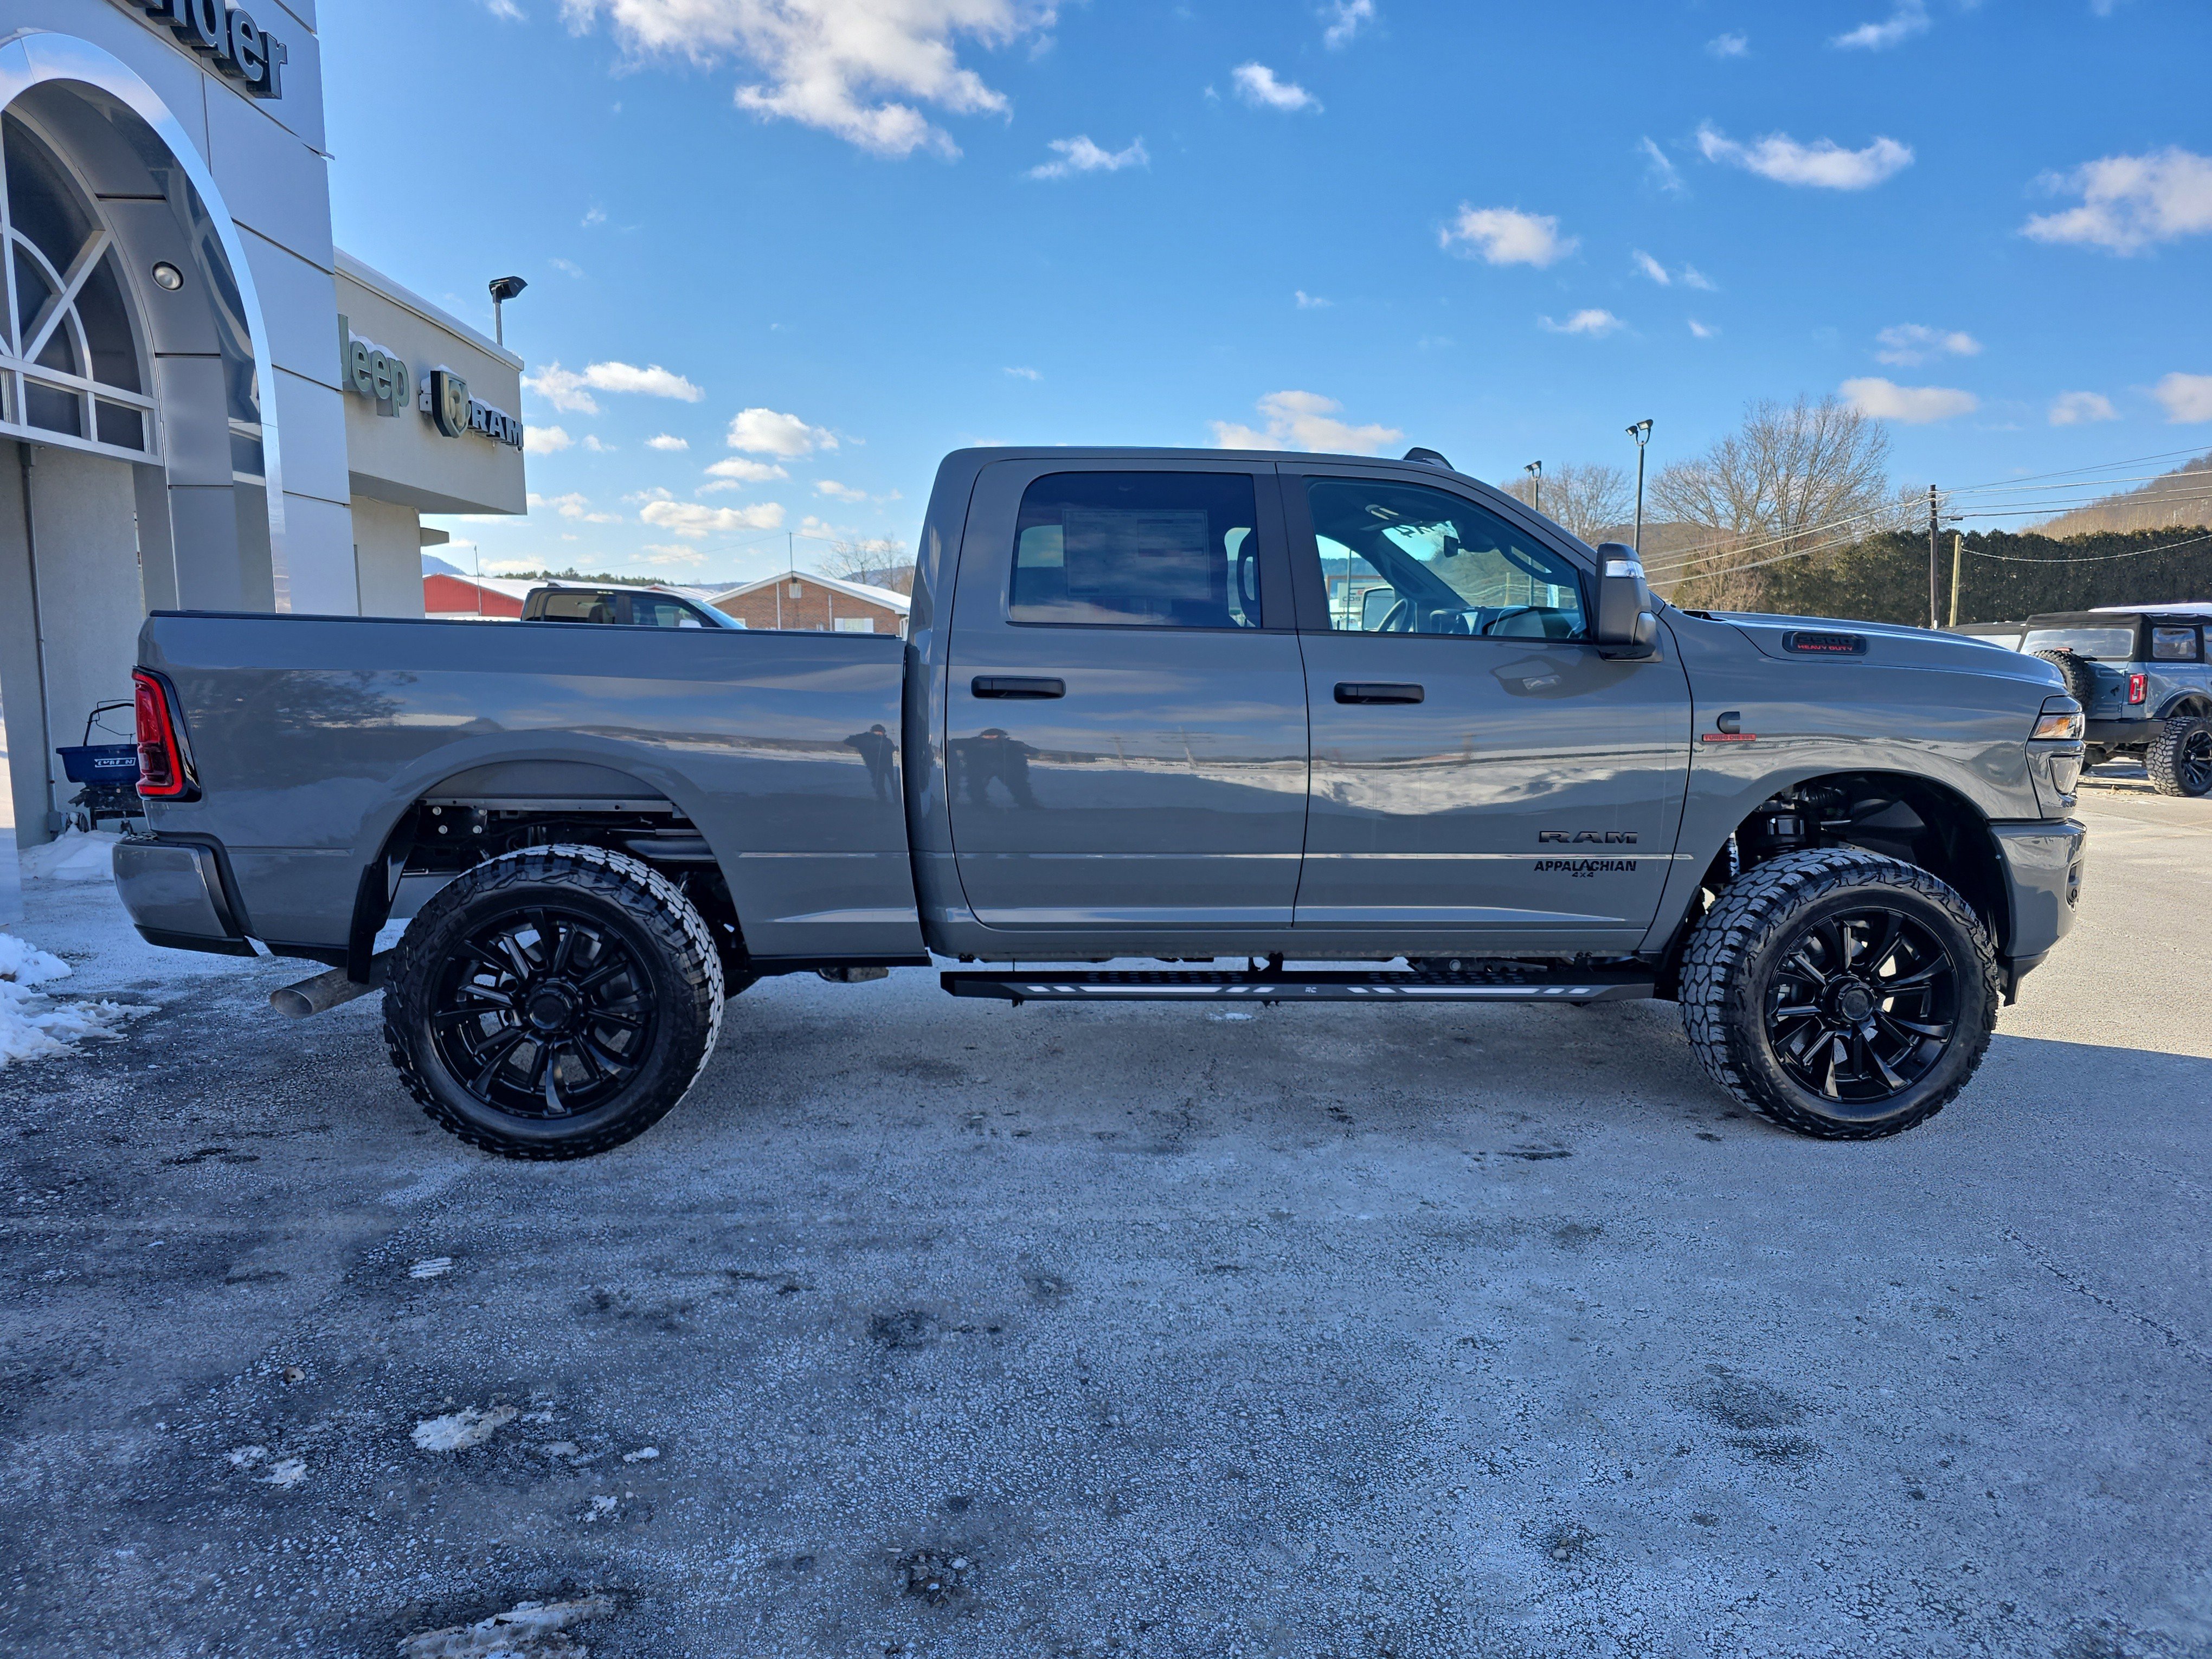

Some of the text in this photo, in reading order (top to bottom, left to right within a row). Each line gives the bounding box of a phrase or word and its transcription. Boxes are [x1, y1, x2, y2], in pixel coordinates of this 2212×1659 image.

[133, 0, 287, 99] der
[470, 400, 524, 448] RAM
[1539, 831, 1638, 844] RAM
[1534, 859, 1637, 872] APPALACHIAN
